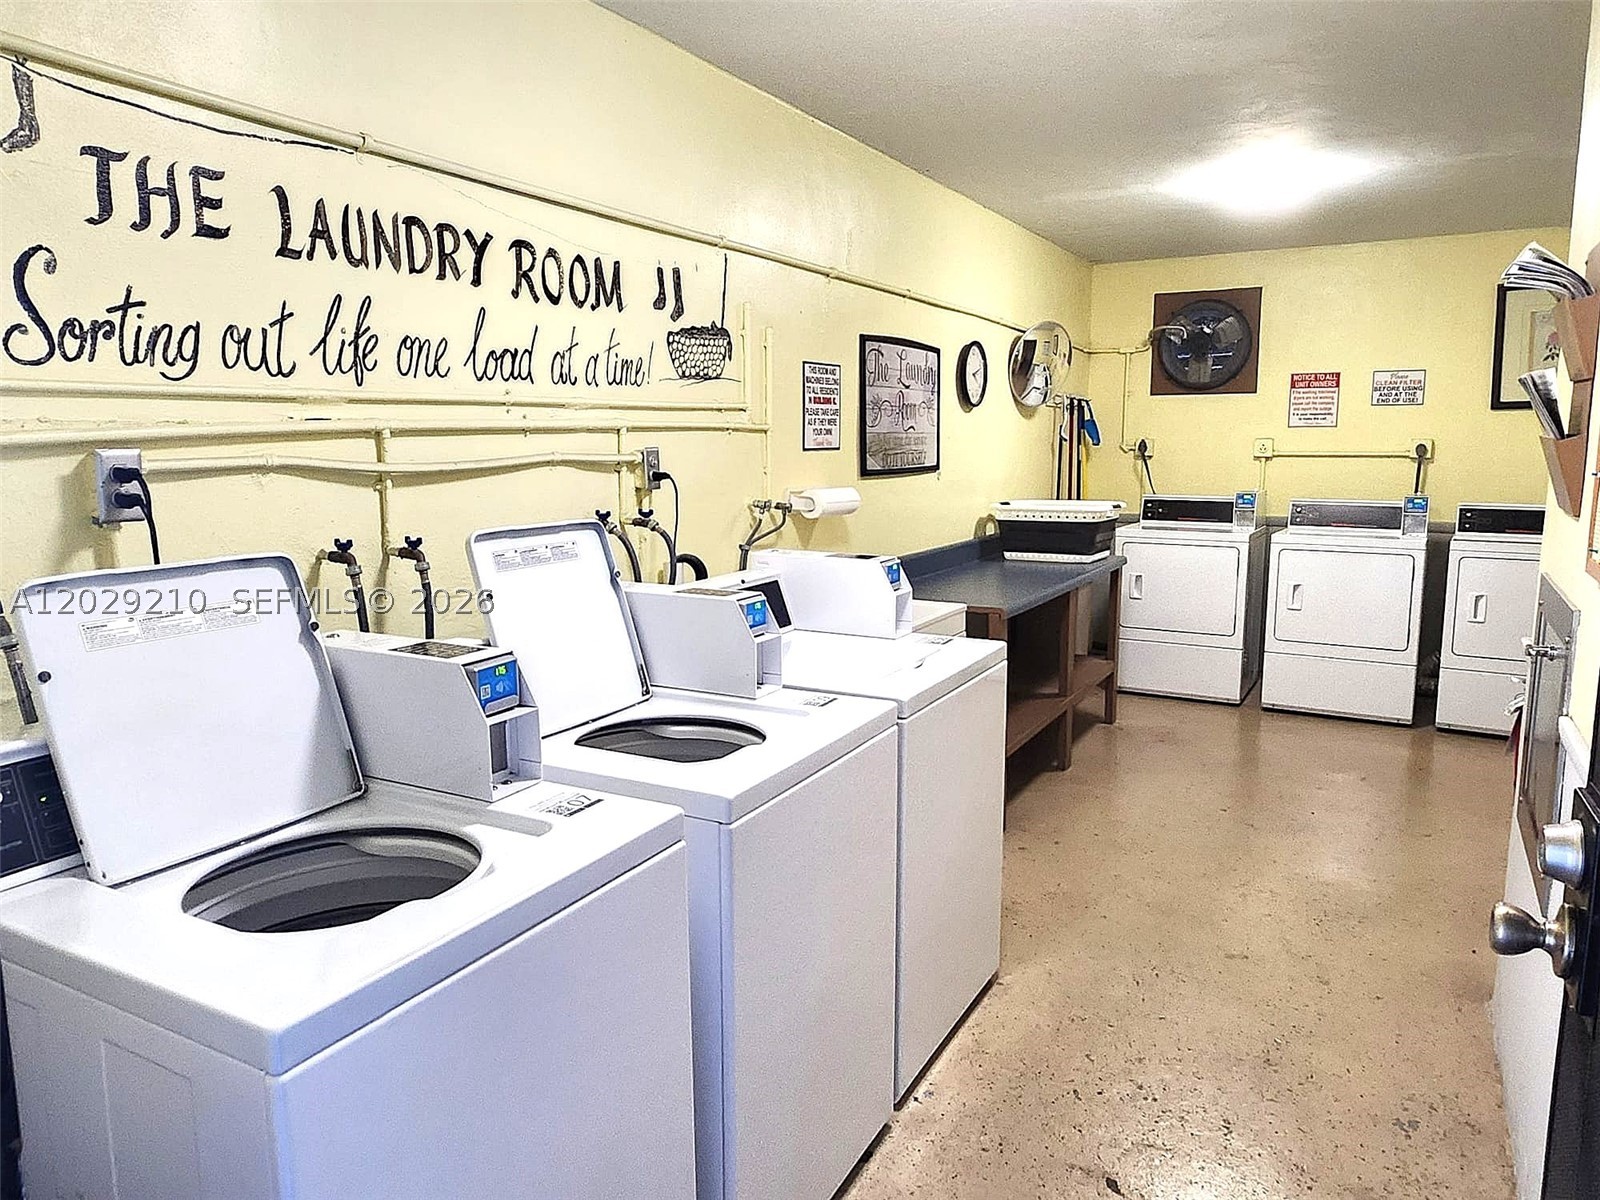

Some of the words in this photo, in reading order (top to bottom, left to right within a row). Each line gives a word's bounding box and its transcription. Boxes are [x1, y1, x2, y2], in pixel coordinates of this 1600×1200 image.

[79, 145, 231, 239] THE
[269, 184, 494, 288] LAUNDRY
[508, 239, 628, 313] ROOM
[3, 244, 202, 381] Sorting
[222, 300, 297, 378] out
[309, 293, 379, 387] life
[397, 334, 451, 379] one
[464, 306, 539, 385] load
[551, 326, 579, 386] at
[585, 353, 600, 387] a
[604, 328, 654, 388] time!
